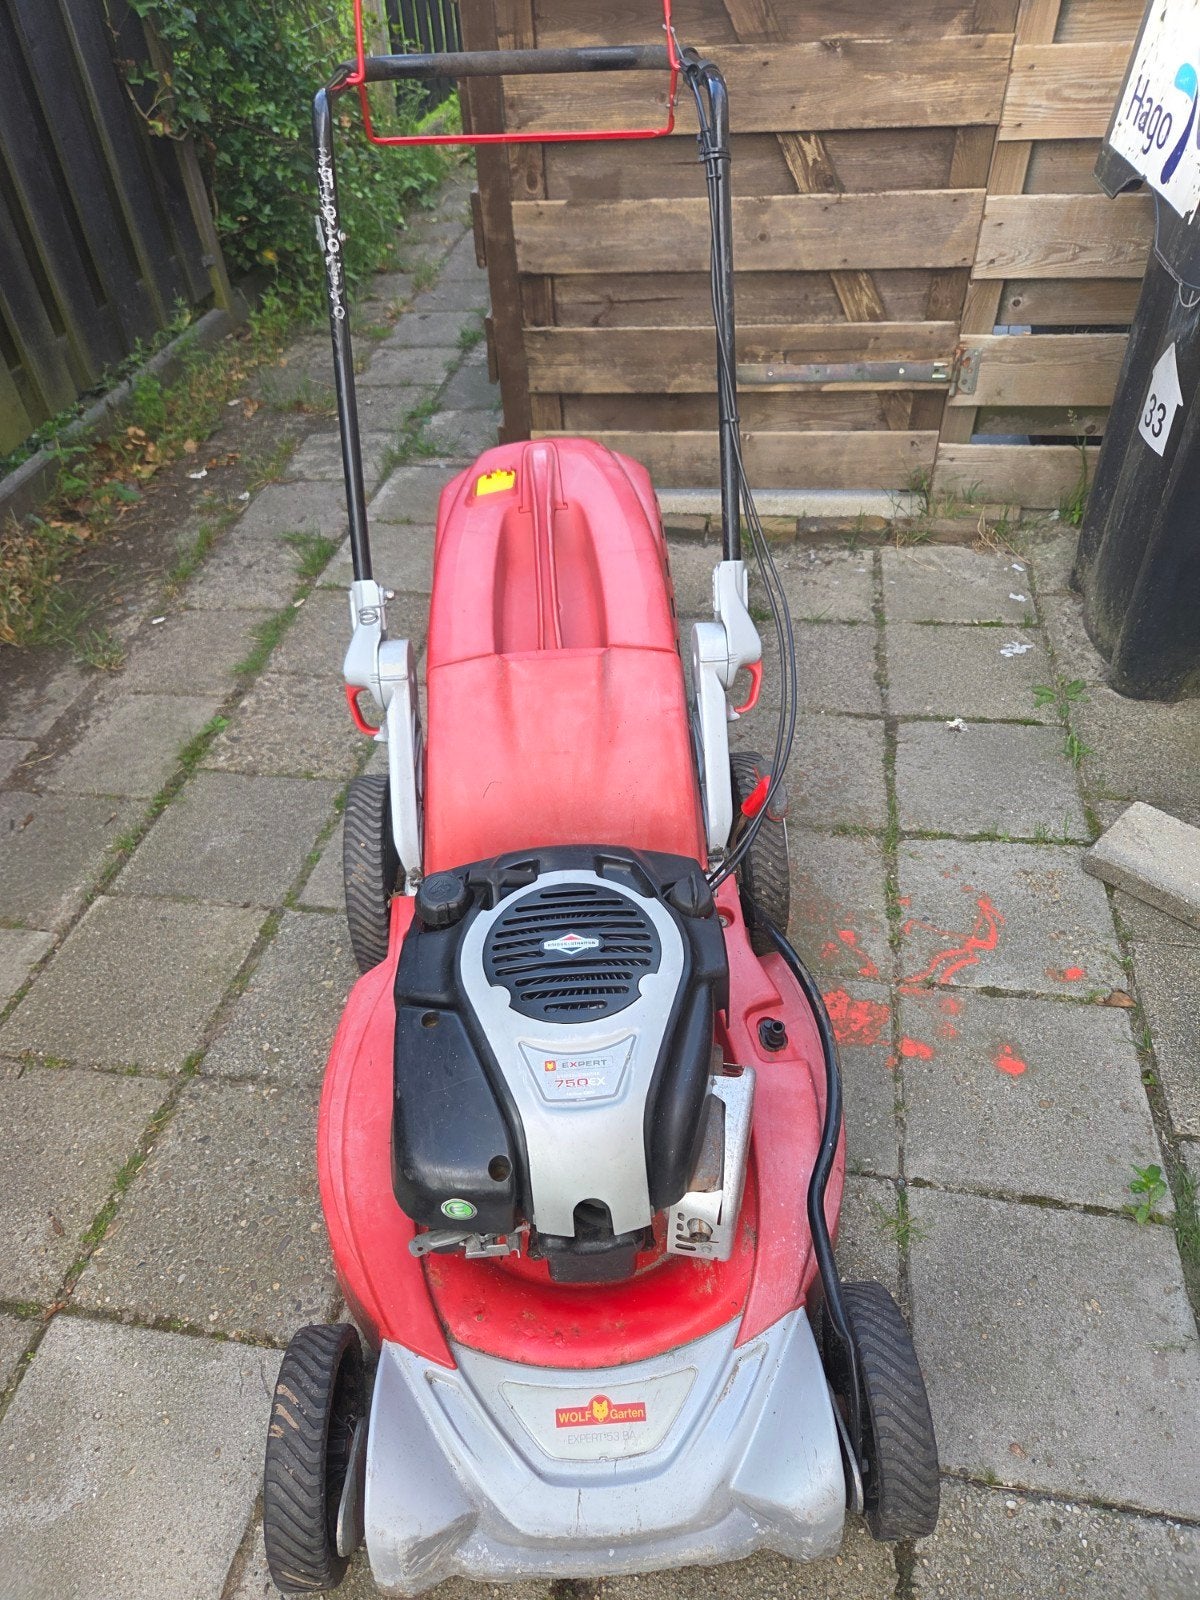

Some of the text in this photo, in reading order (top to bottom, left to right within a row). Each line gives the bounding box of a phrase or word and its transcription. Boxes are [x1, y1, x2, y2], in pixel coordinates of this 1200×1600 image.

[1126, 74, 1173, 155] Hago
[1144, 393, 1167, 438] 33
[562, 1059, 608, 1069] EXPERT
[558, 1408, 645, 1424] WOLF Garten
[567, 1432, 604, 1445] EXPERT
